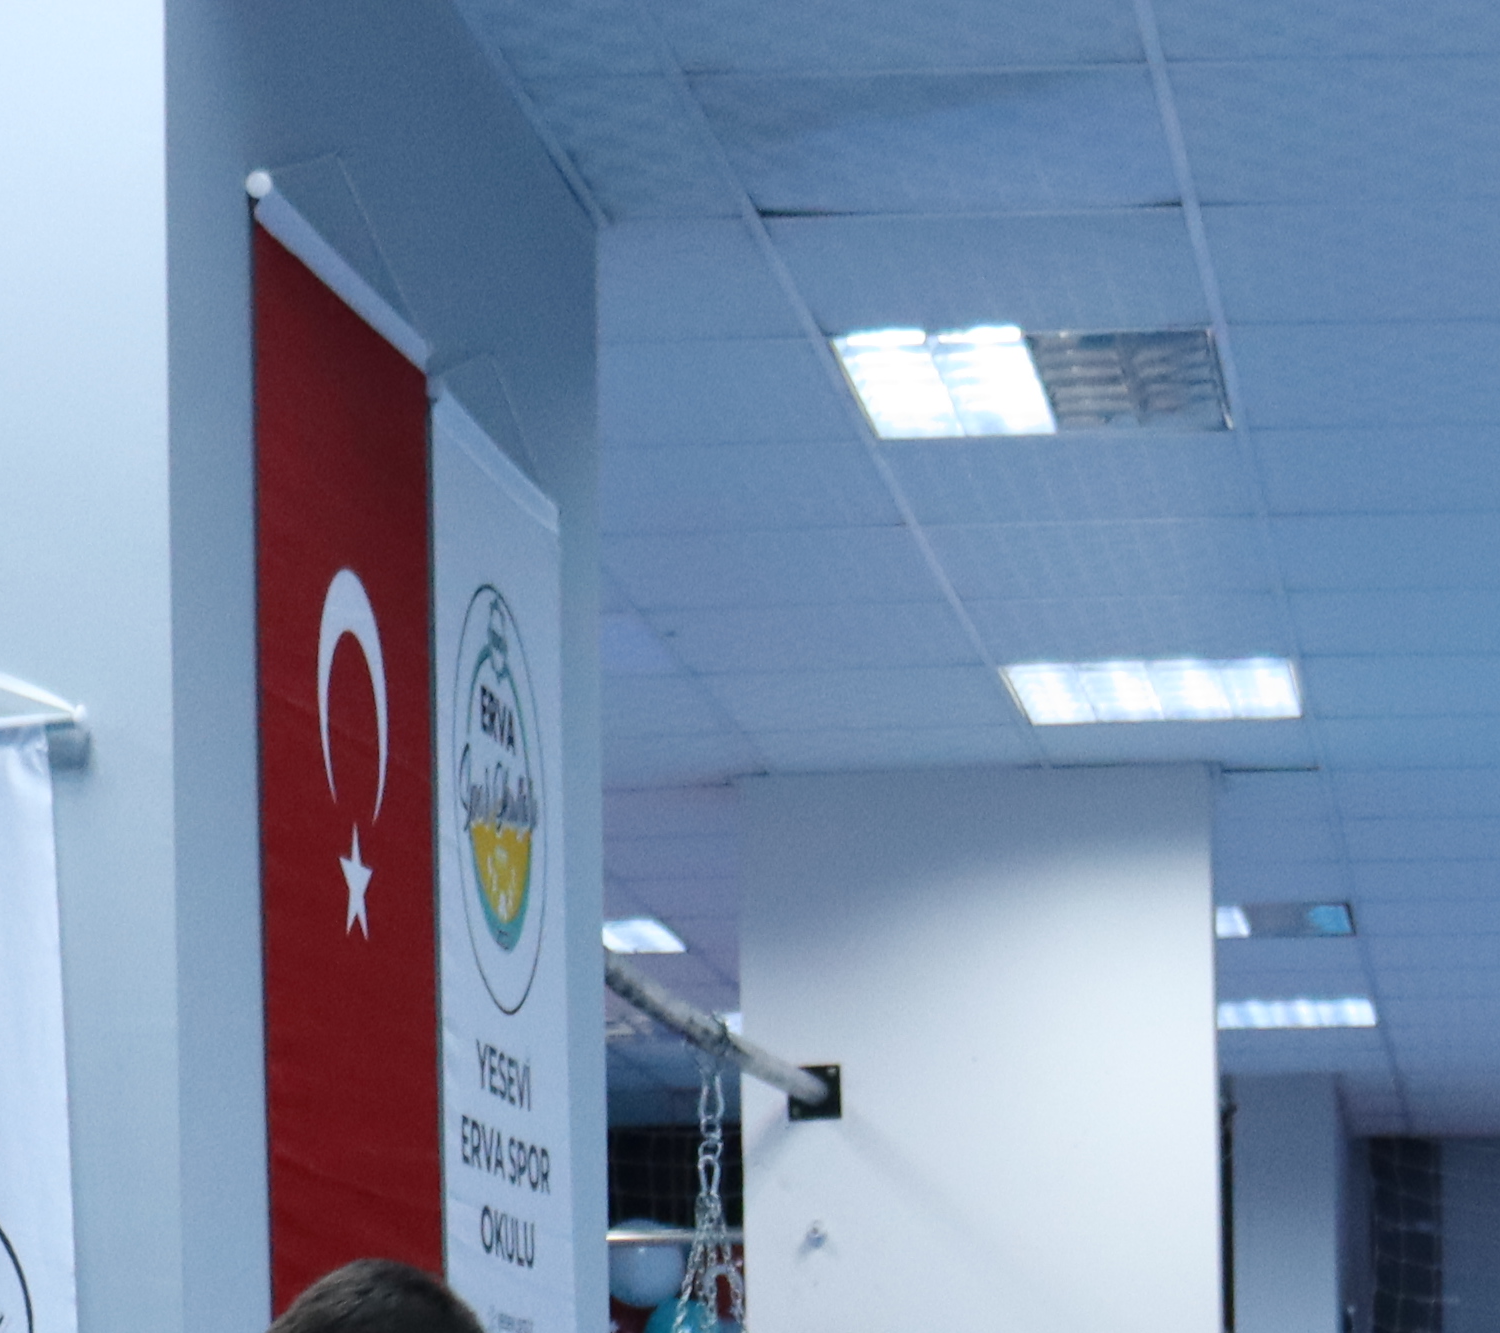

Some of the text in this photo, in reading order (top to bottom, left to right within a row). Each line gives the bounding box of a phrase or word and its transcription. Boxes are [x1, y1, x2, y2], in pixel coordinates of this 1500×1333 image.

[480, 684, 517, 757] ERVA
[476, 1038, 531, 1112] YESEVİ
[461, 1114, 551, 1196] ERVA SPOR
[480, 1204, 535, 1269] OKULU
